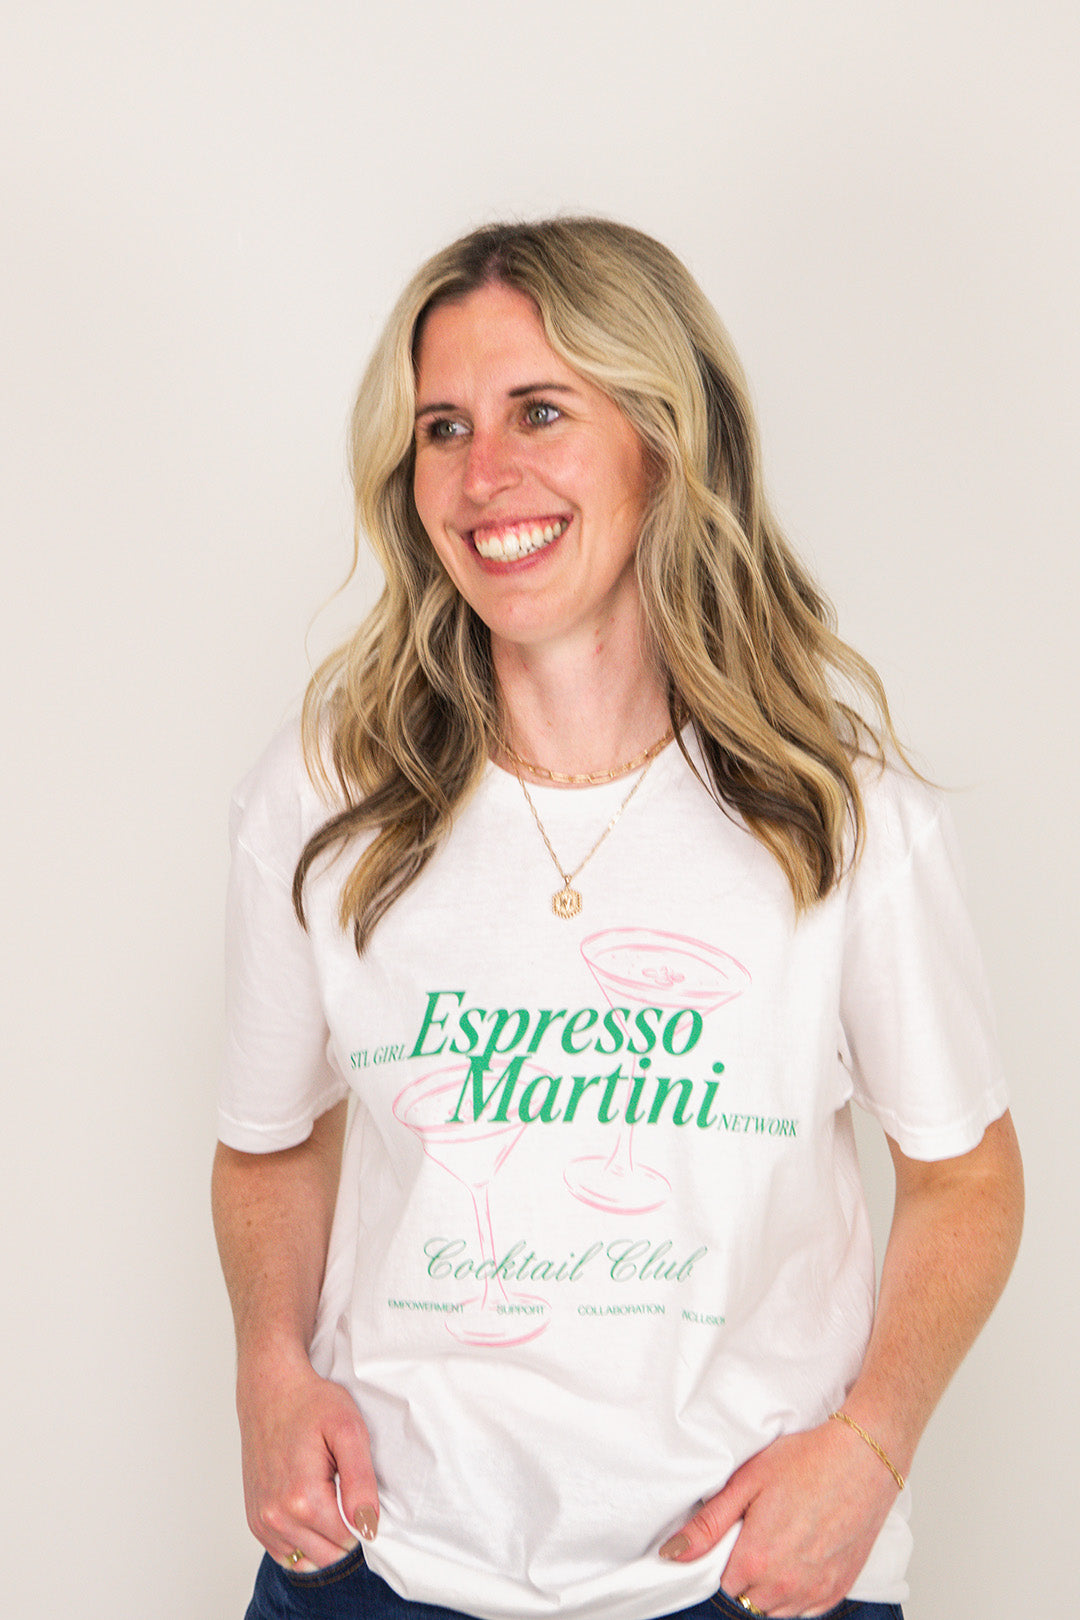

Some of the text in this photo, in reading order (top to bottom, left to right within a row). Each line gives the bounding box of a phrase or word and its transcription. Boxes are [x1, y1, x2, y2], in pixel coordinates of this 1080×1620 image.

[350, 990, 704, 1074] STL GIRL Espresso
[445, 1056, 799, 1138] Martini NETWORK
[423, 1236, 708, 1282] Cocktail Club
[387, 1298, 465, 1314] EMPOWERMENT
[496, 1303, 545, 1316] SUPPORT
[577, 1303, 666, 1317] COLLABORATION
